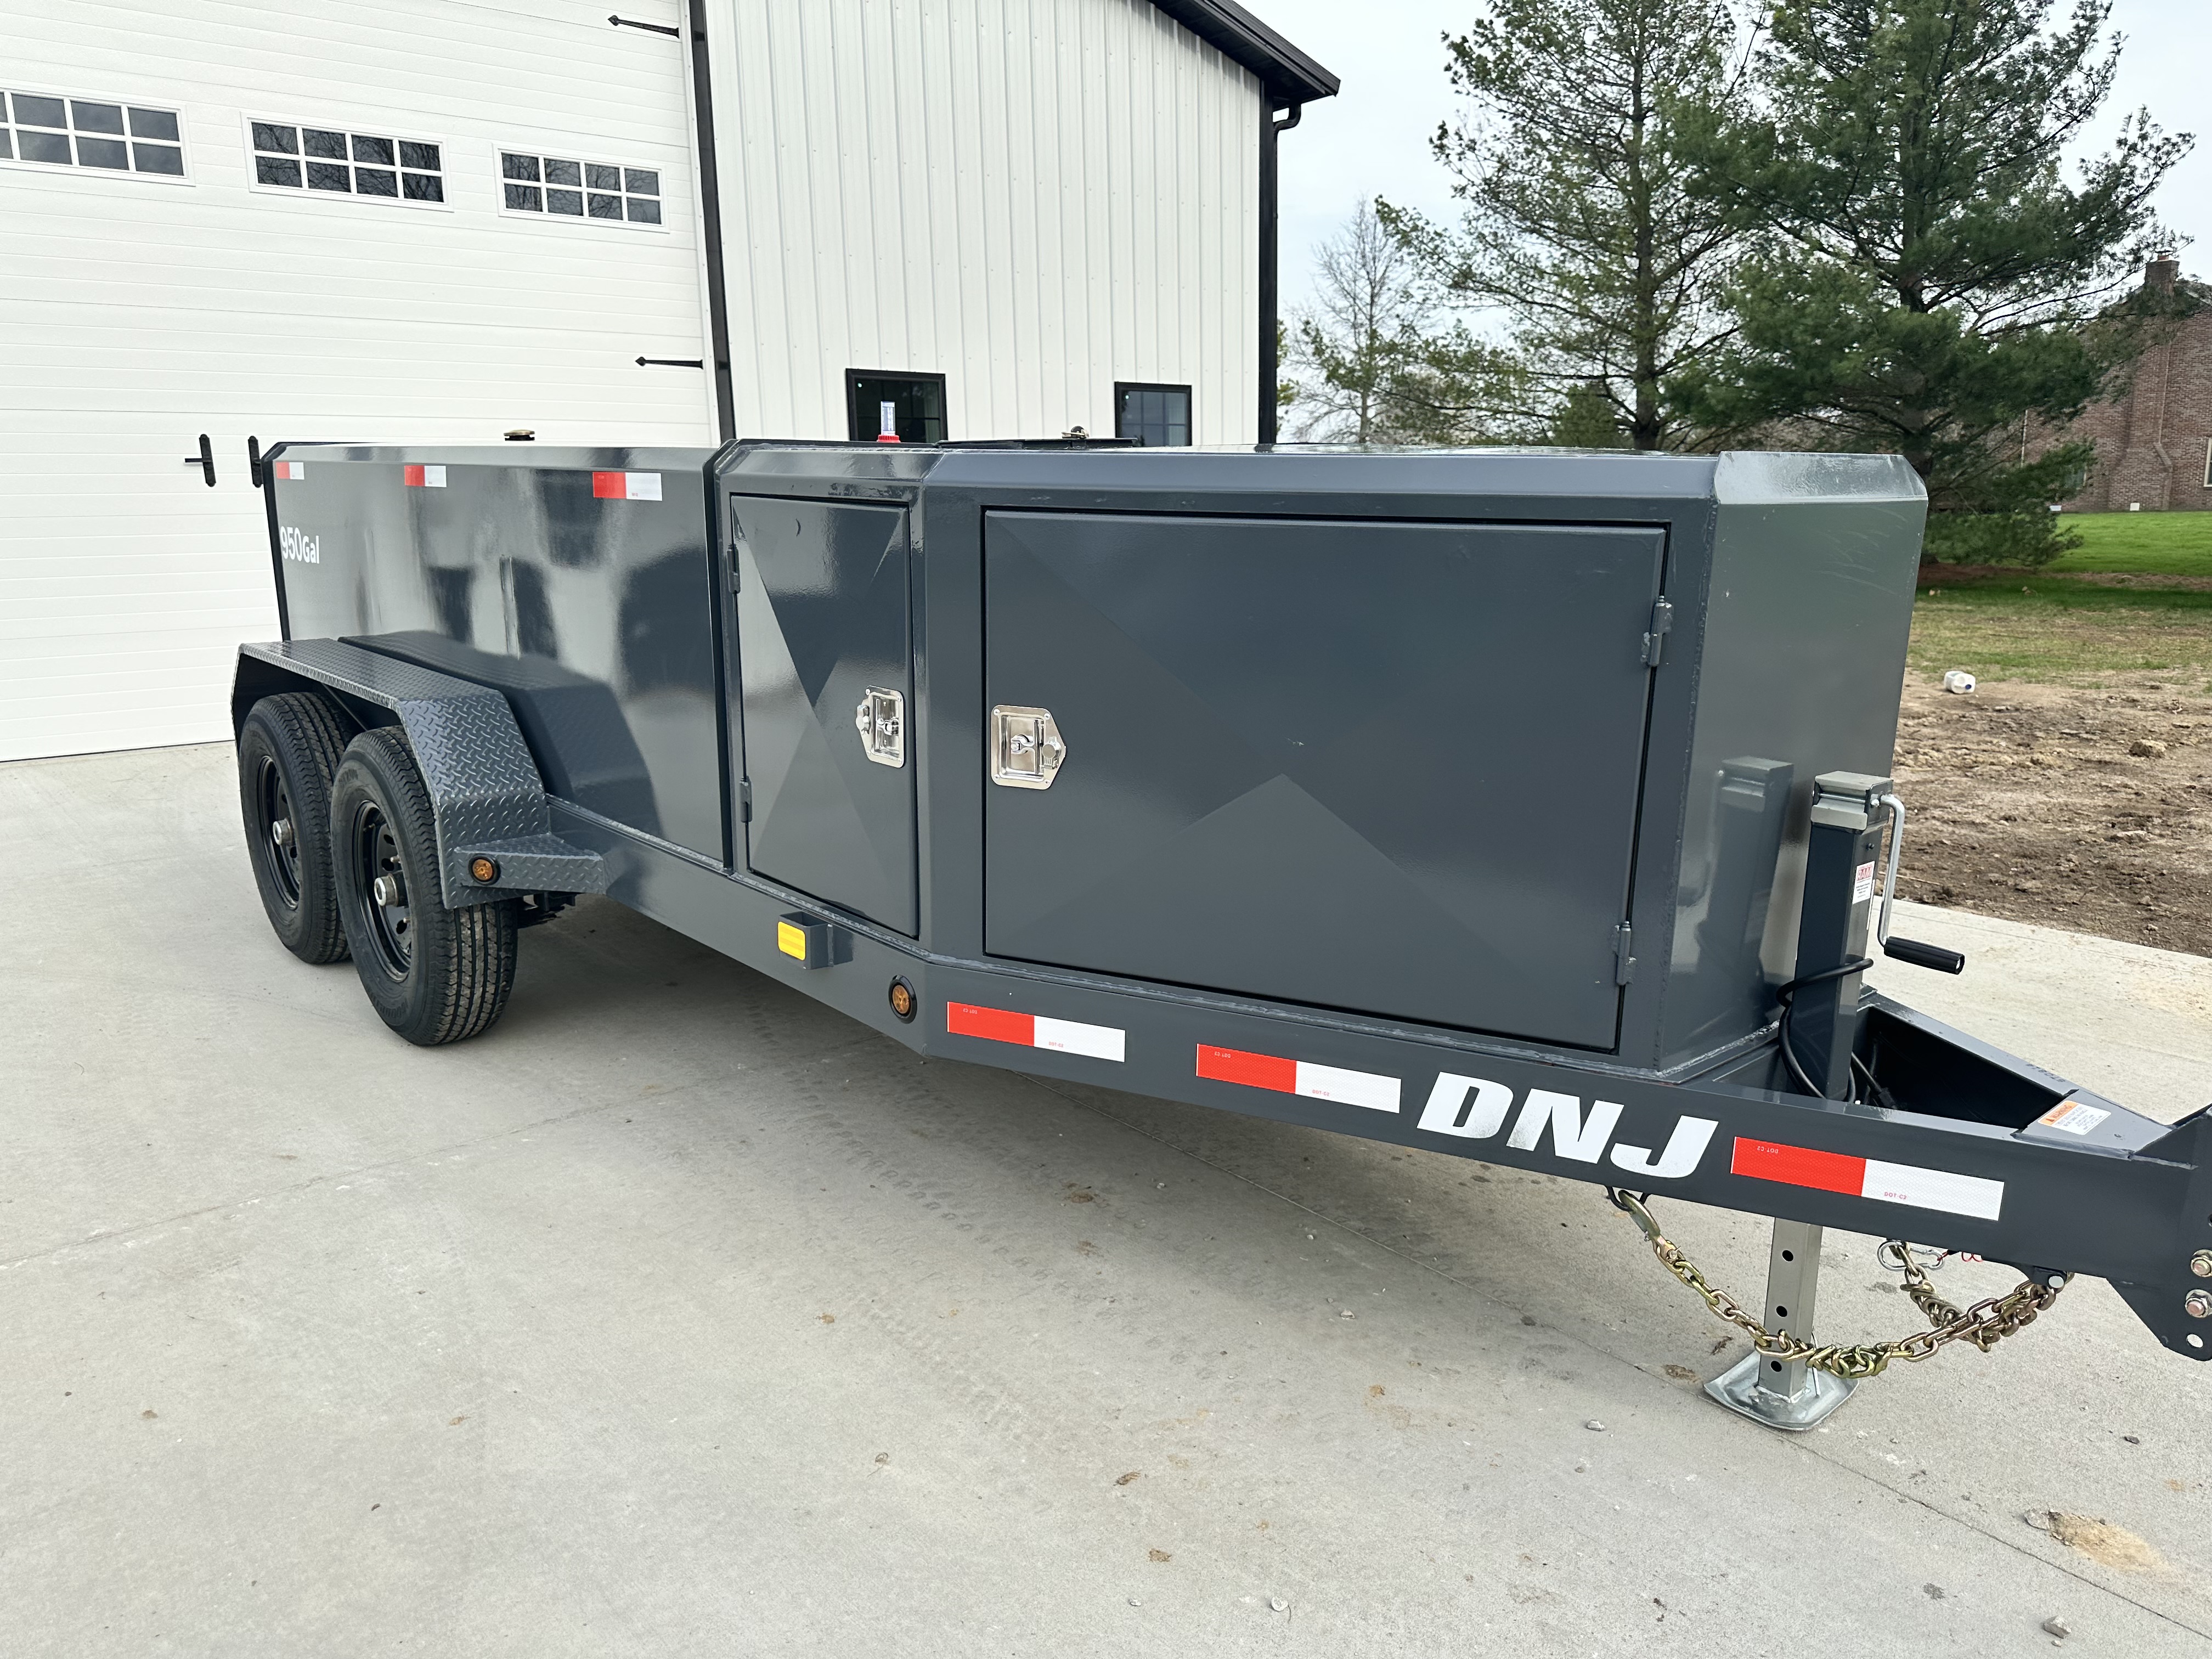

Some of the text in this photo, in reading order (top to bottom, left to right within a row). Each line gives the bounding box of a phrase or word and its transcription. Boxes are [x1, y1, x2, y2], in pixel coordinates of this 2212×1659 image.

[1857, 866, 1873, 881] RAM
[2050, 1104, 2073, 1119] WARNING
[1417, 1071, 1719, 1178] DNJ
[1884, 1192, 1907, 1200] DOT-C2
